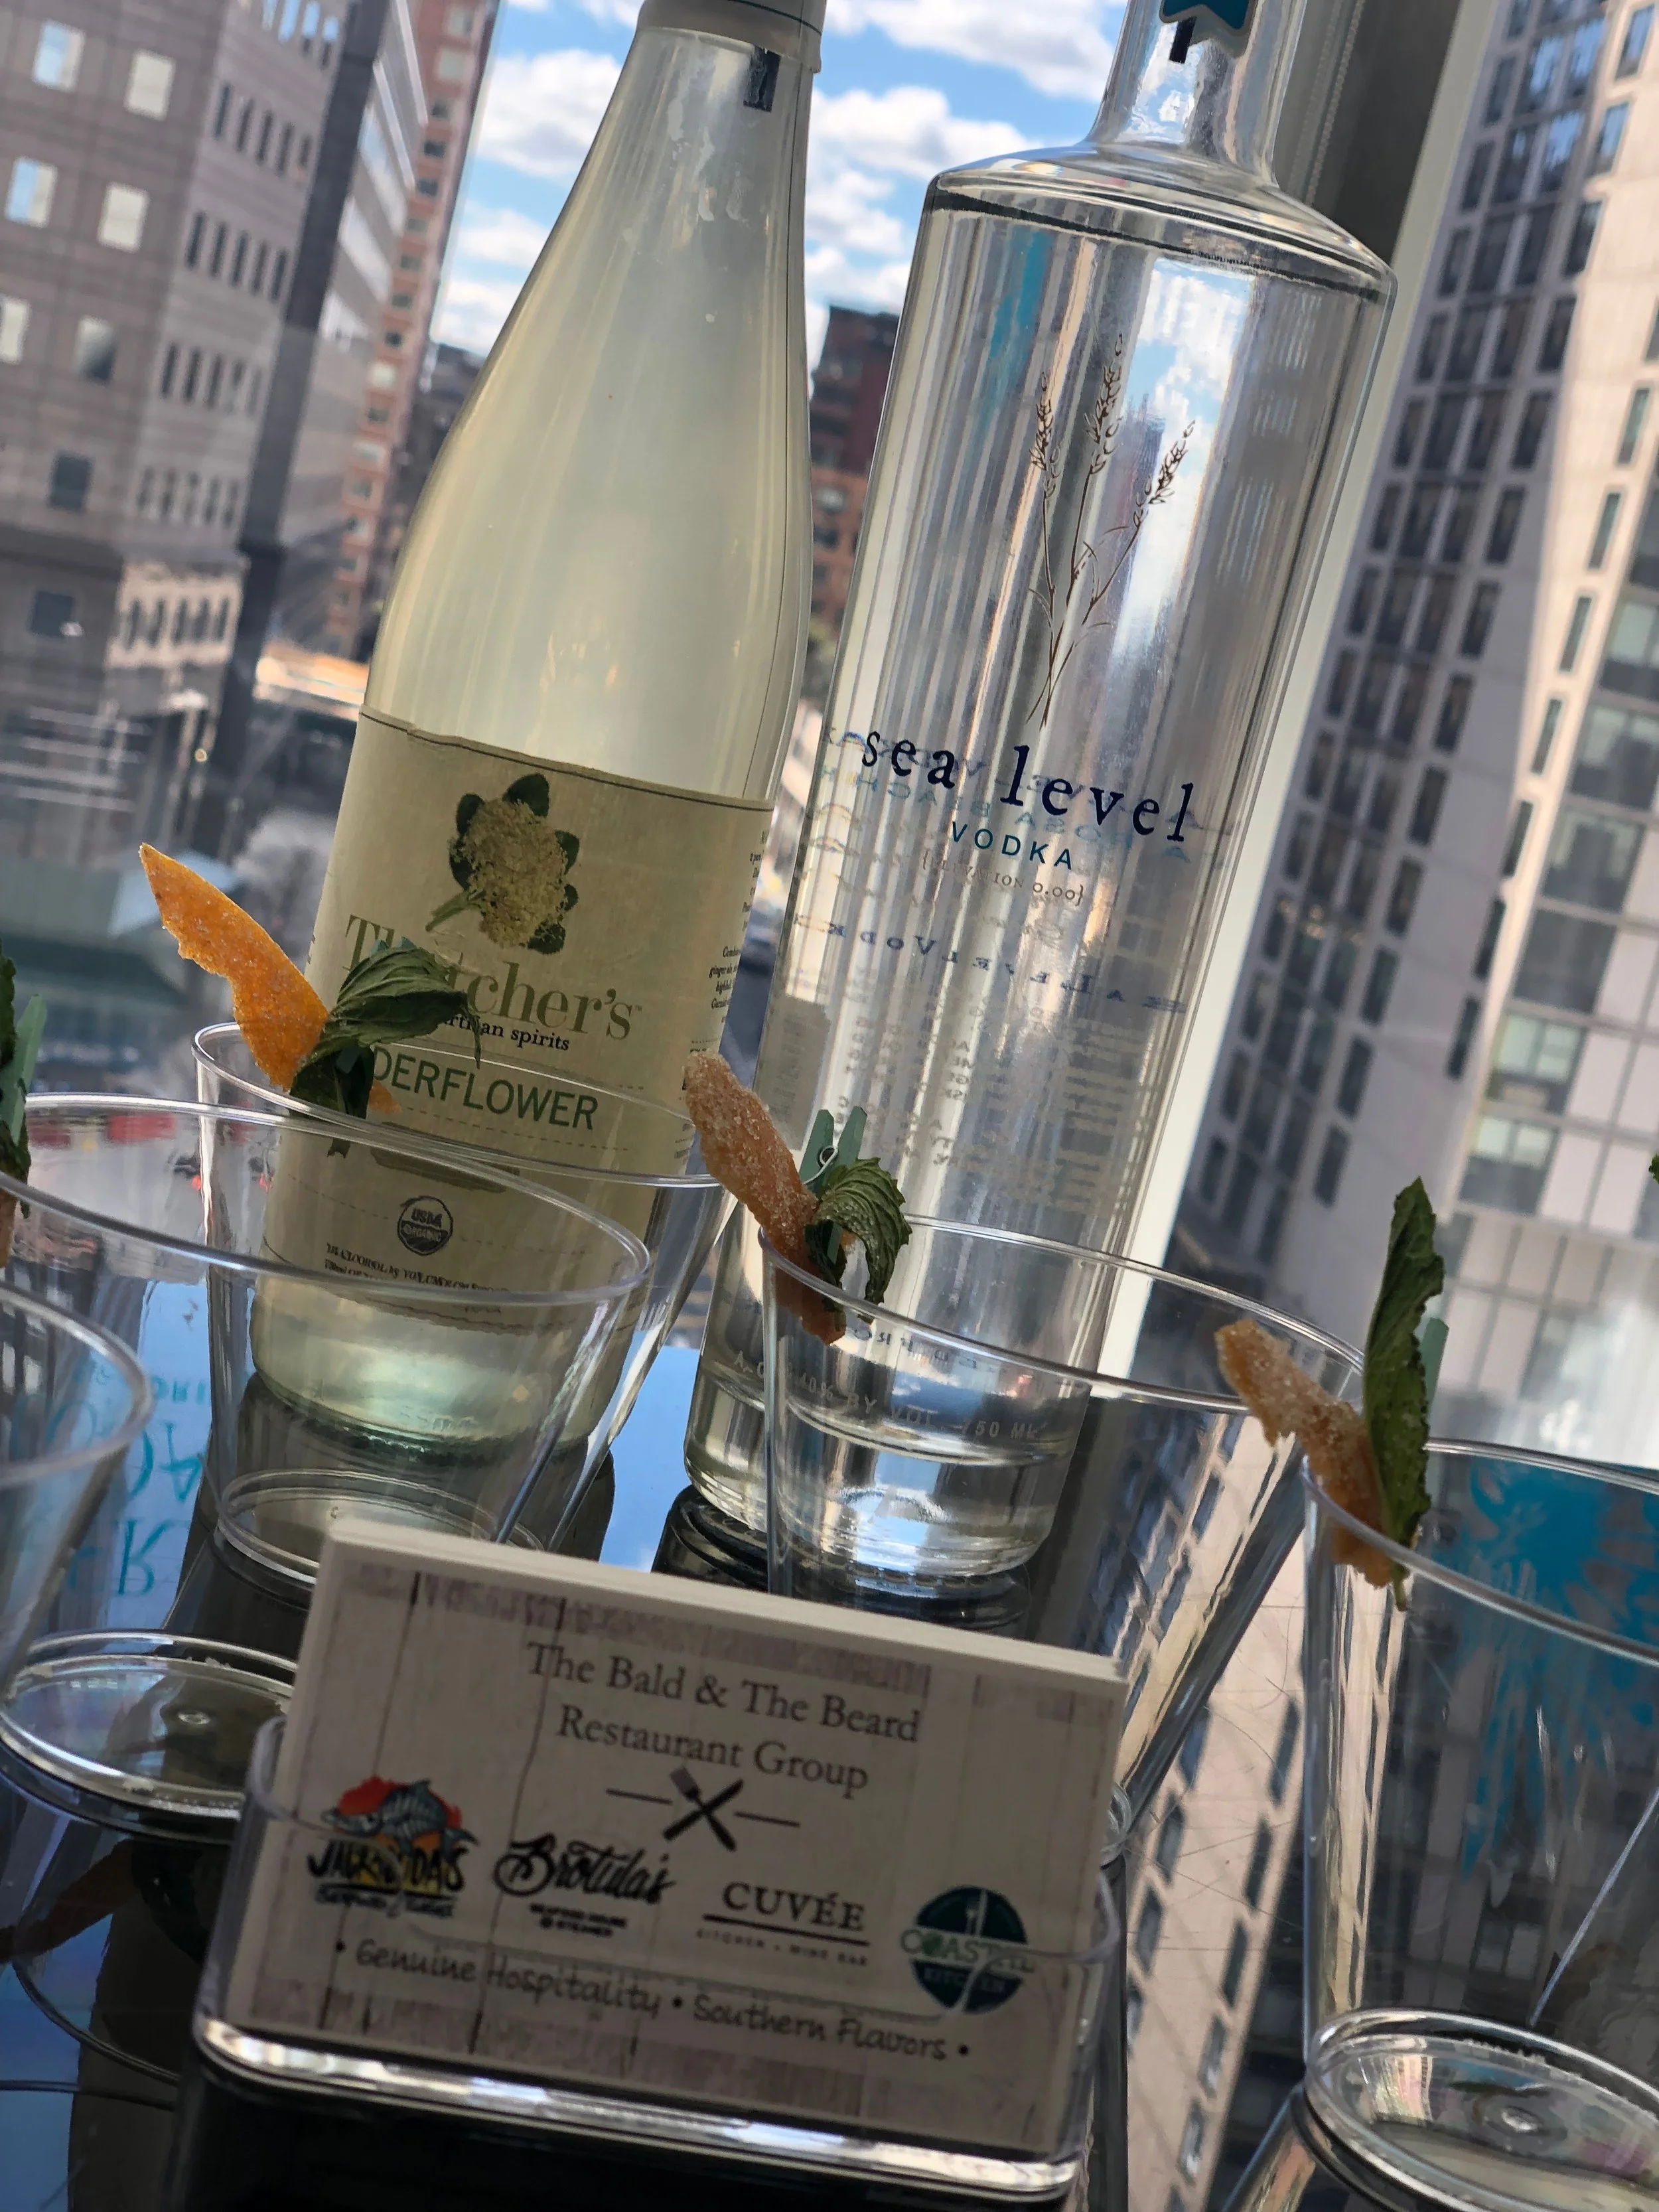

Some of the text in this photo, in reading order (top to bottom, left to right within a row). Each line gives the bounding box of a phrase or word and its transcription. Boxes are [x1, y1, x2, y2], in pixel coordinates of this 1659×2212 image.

[862, 731, 955, 789] sea
[999, 744, 1194, 842] level
[951, 821, 1072, 870] VODKA
[510, 1028, 569, 1051] spirits
[372, 1046, 599, 1130] DERFLOWER
[528, 1641, 920, 1743] The Bald & The Beard
[556, 1703, 869, 1801] Restaurant Group
[721, 1881, 865, 1931] CUVÉE
[356, 1937, 948, 2061] Genuine Hospitality Southern Flavors
